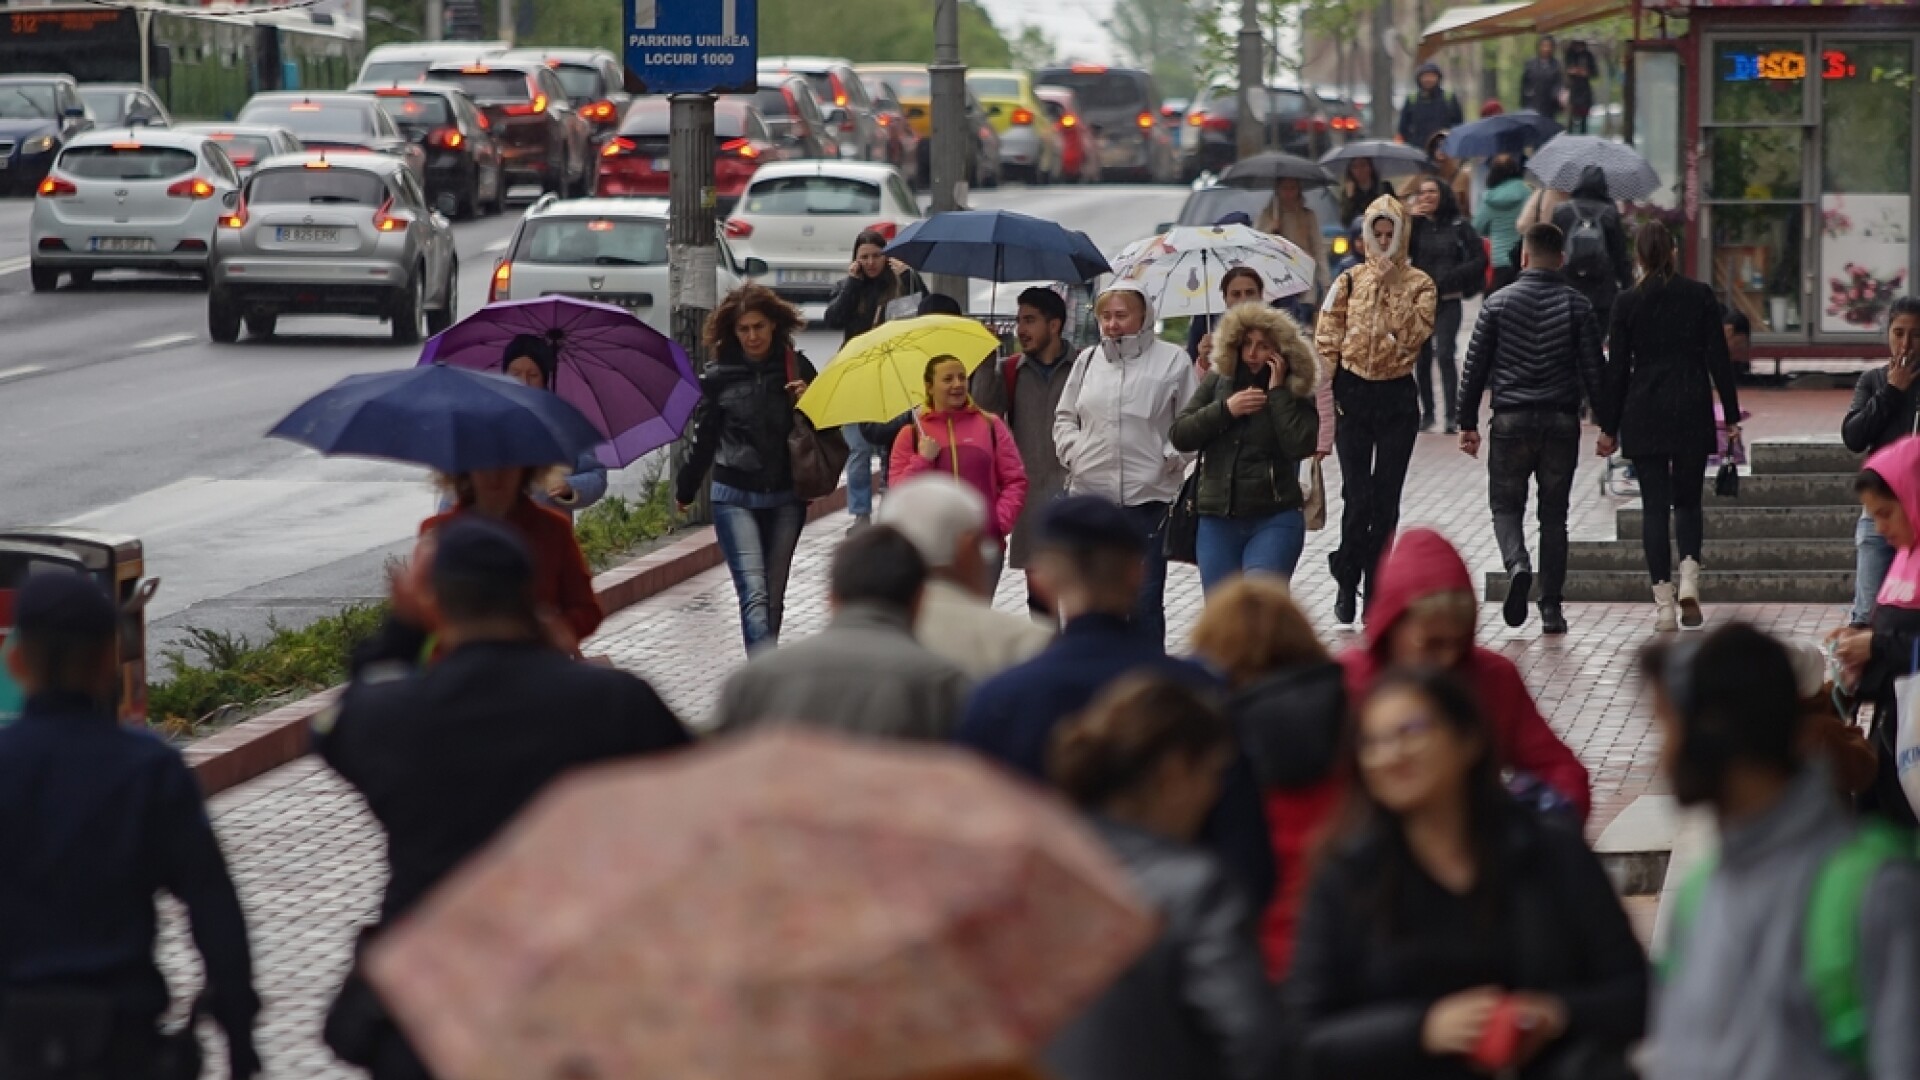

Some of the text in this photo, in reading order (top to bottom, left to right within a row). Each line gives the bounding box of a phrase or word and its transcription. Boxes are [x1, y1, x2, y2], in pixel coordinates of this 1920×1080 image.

[10, 13, 39, 34] 312
[629, 34, 750, 47] PARKING UNIREA
[644, 53, 735, 66] LOCURI 1000
